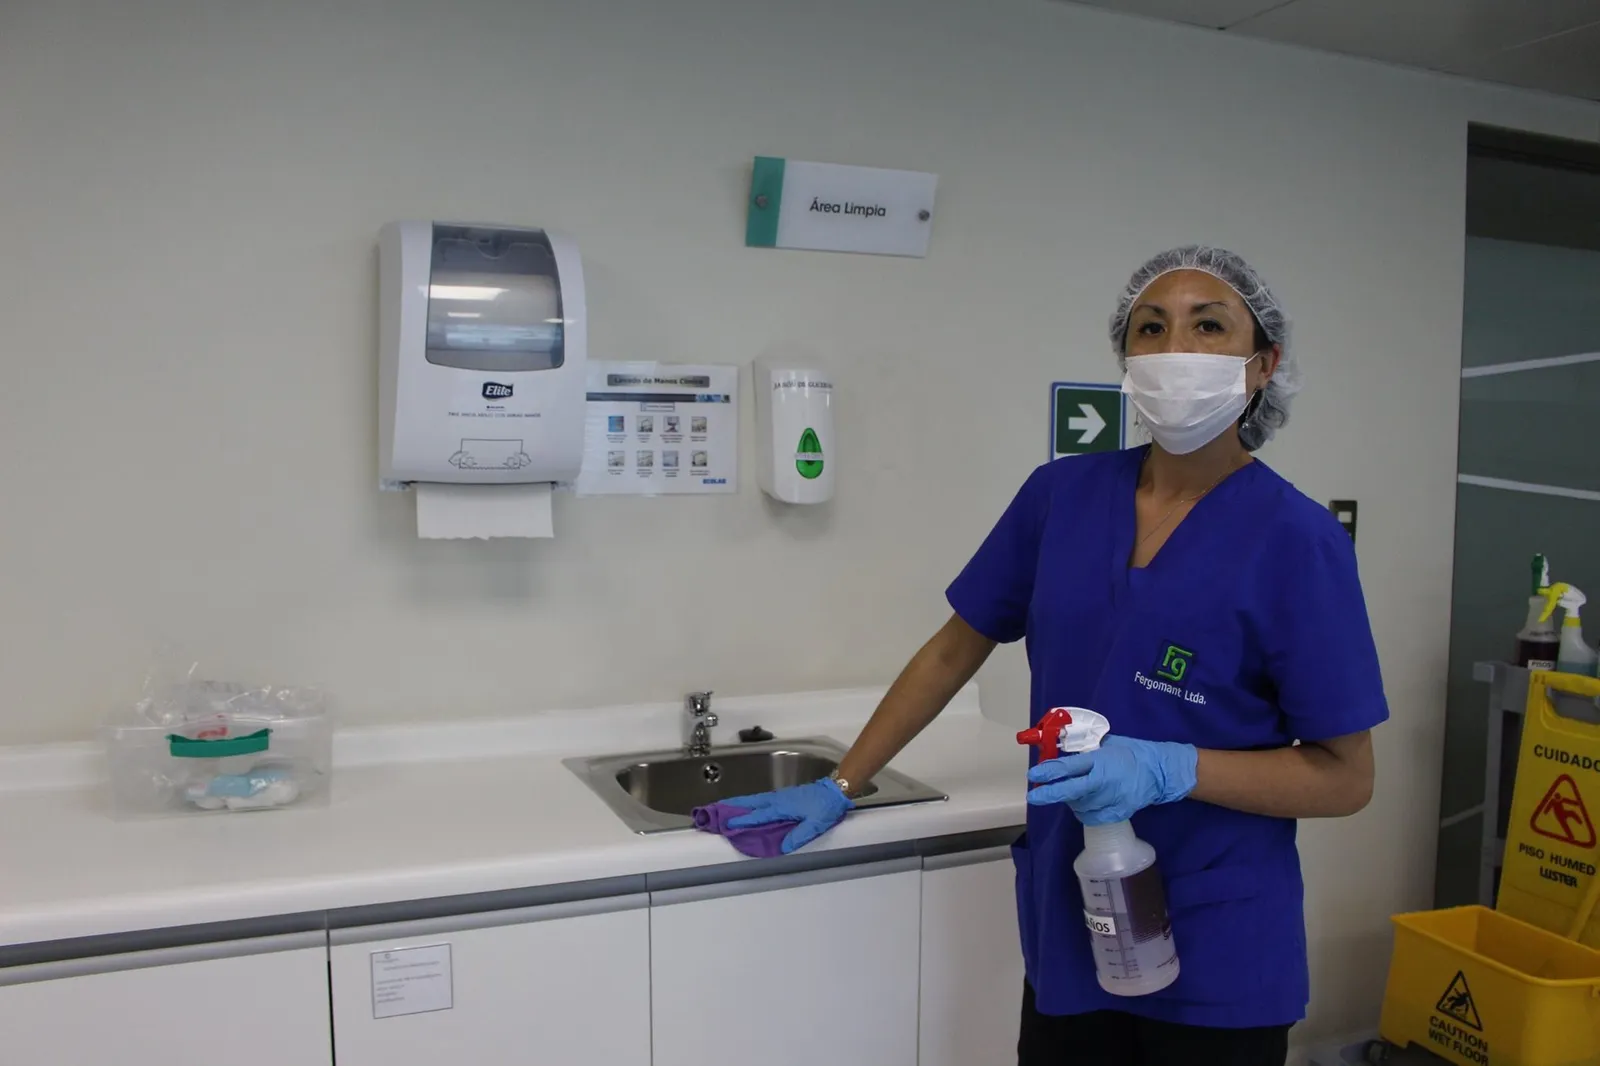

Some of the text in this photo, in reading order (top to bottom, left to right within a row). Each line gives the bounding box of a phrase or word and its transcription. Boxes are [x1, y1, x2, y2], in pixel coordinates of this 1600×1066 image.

[809, 197, 886, 219] Área Limpia
[485, 385, 512, 396] Elite
[1134, 671, 1207, 705] Fergomant Ltda.
[1518, 842, 1597, 876] PISO HUMED
[1539, 865, 1578, 888] LUSTER
[1428, 1027, 1489, 1066] WET FLOOR
[1429, 1016, 1488, 1053] CAUTION
